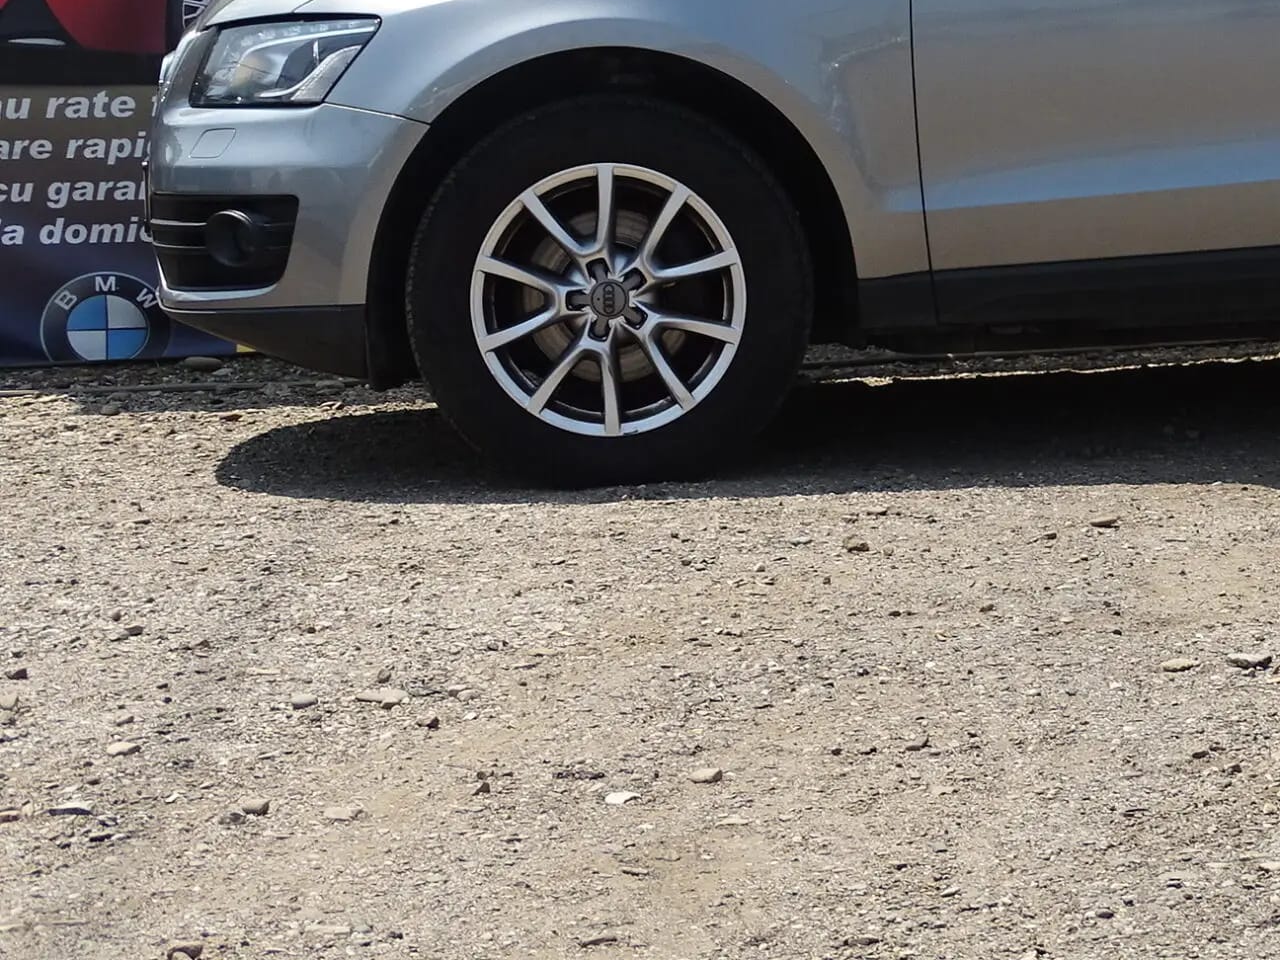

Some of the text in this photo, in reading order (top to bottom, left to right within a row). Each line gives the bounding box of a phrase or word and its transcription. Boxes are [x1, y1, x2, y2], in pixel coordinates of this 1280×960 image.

[45, 90, 137, 119] rate
[65, 131, 152, 166] rapi
[54, 275, 160, 311] BMW
